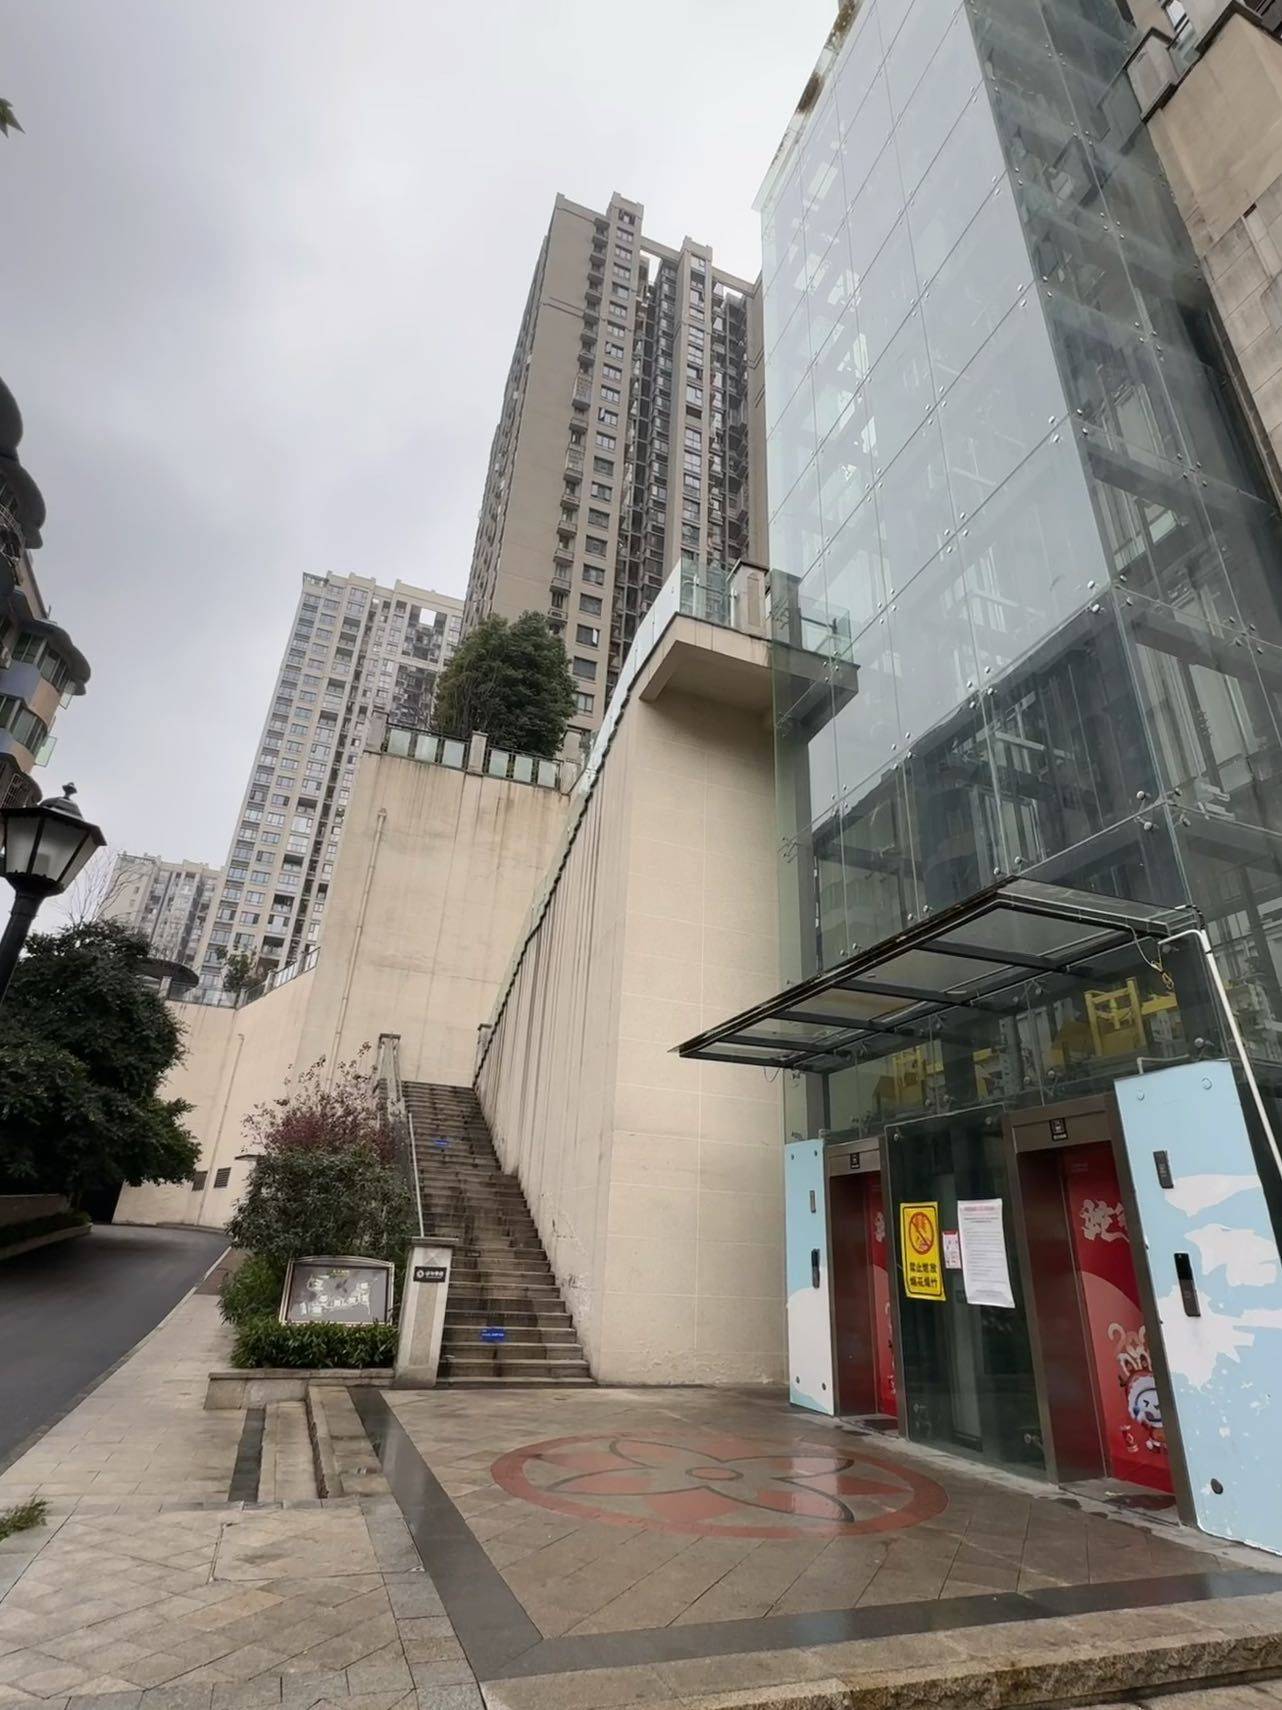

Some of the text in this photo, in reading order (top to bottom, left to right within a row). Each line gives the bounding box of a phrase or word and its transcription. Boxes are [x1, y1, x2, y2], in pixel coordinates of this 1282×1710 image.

[910, 1262, 937, 1273] 禁止燃放
[910, 1276, 938, 1288] 烟花爆竹
